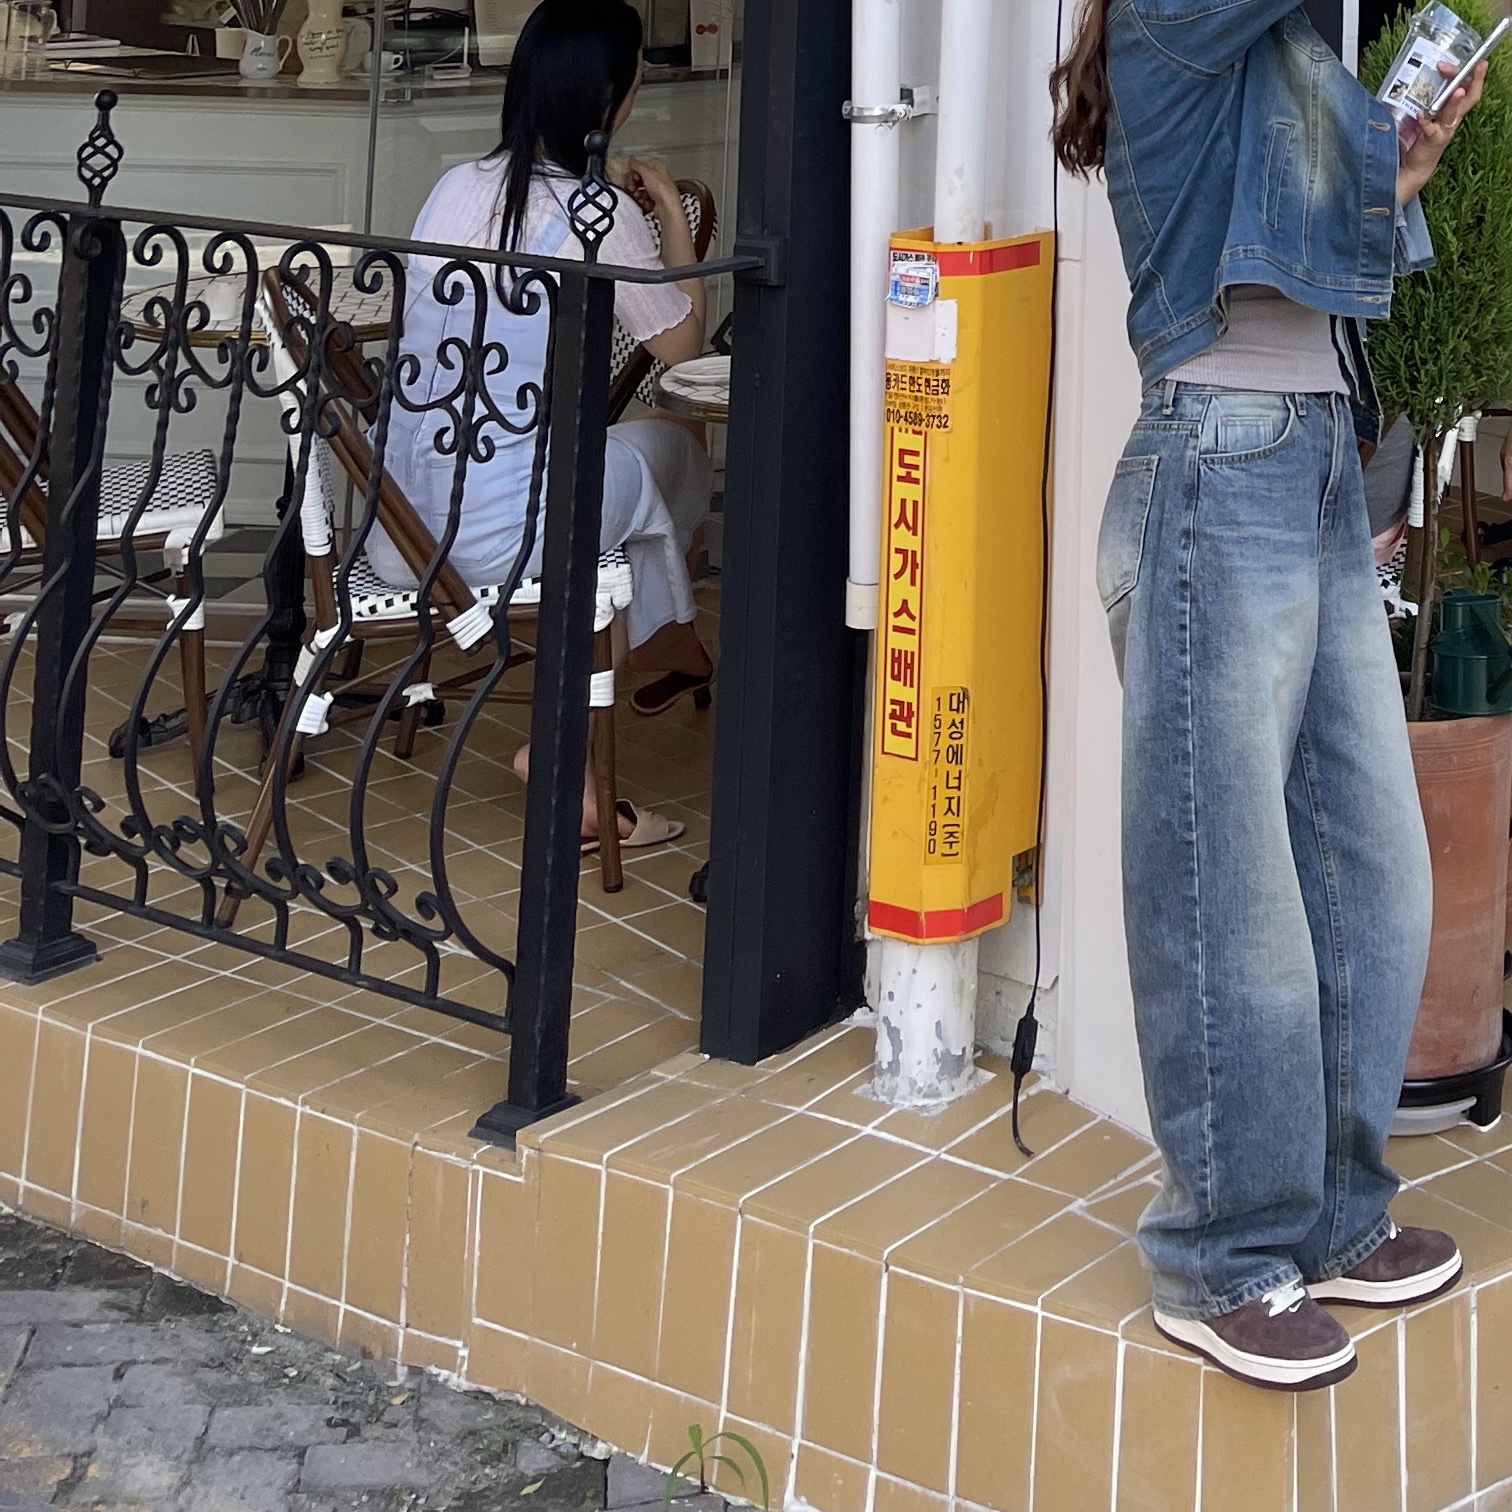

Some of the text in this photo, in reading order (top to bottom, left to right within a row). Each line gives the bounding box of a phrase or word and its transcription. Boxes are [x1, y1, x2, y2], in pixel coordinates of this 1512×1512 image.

[886, 407, 950, 430] 010-4589-3732
[924, 377, 951, 397] 현금화
[888, 426, 922, 739] 도시가스배관
[927, 696, 942, 855] 1577-1190
